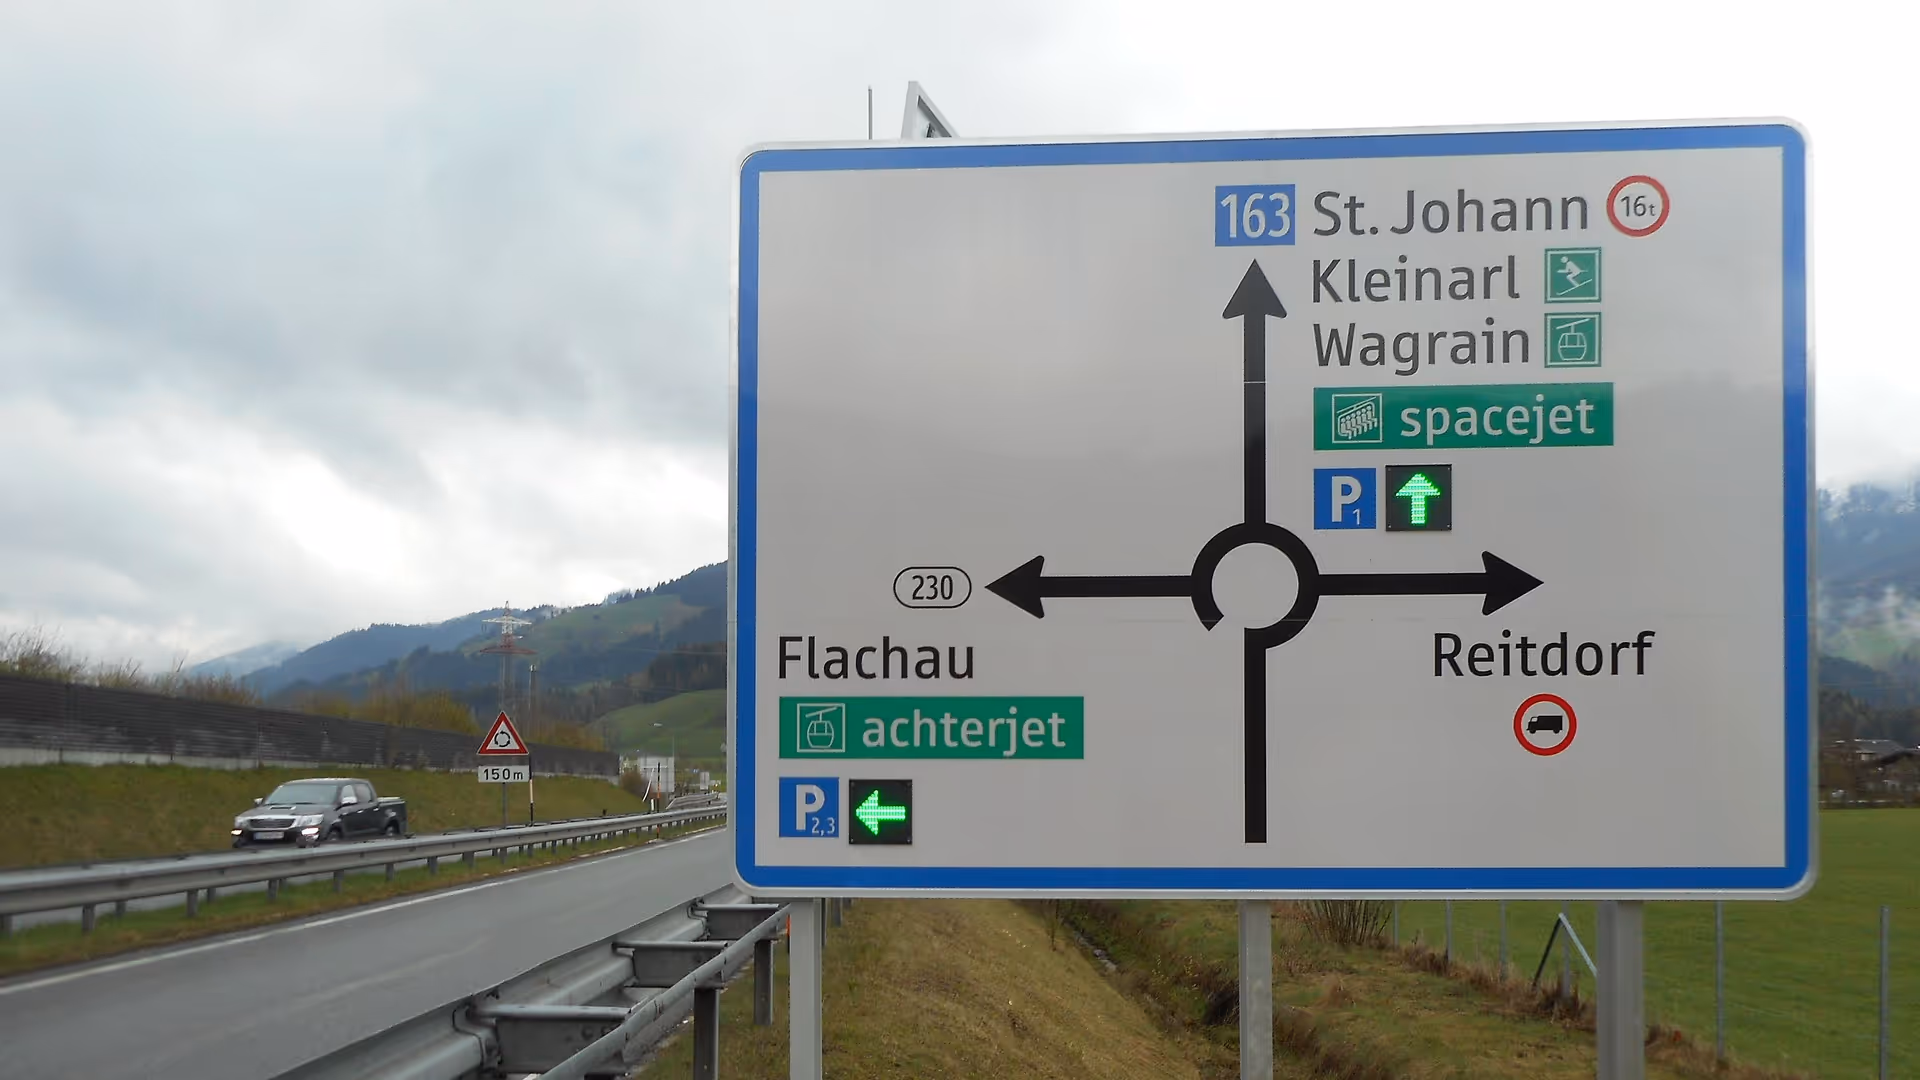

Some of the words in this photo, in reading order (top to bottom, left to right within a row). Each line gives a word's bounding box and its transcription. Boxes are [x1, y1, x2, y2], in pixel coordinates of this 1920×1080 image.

[1220, 192, 1291, 239] 163
[1313, 192, 1379, 236] St.
[1390, 189, 1588, 236] Johann
[1313, 255, 1520, 303] Kleinarl
[1313, 318, 1529, 376] Wagrain
[1400, 394, 1594, 445] spacejet
[912, 575, 953, 600] 230
[779, 636, 973, 679] Flachau
[1434, 629, 1655, 676] Reitdorf
[863, 706, 1066, 757] achterjet
